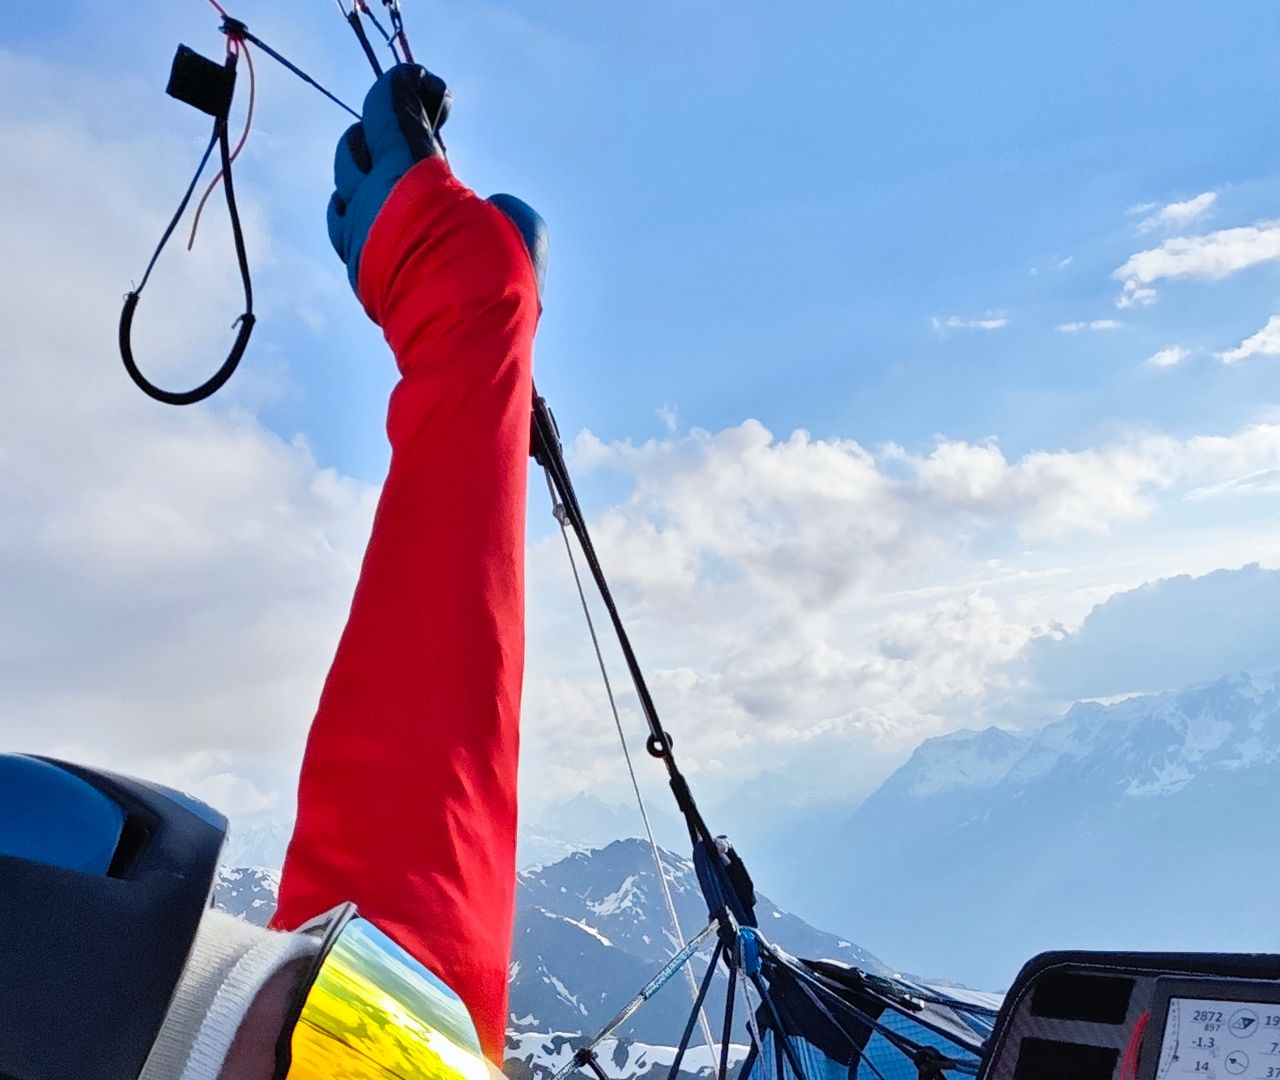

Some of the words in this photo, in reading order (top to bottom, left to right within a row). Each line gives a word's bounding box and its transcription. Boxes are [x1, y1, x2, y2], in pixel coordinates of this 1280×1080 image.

[1192, 1010, 1224, 1022] 2872
[1191, 1036, 1215, 1048] -1.3
[1194, 1060, 1209, 1071] 14
